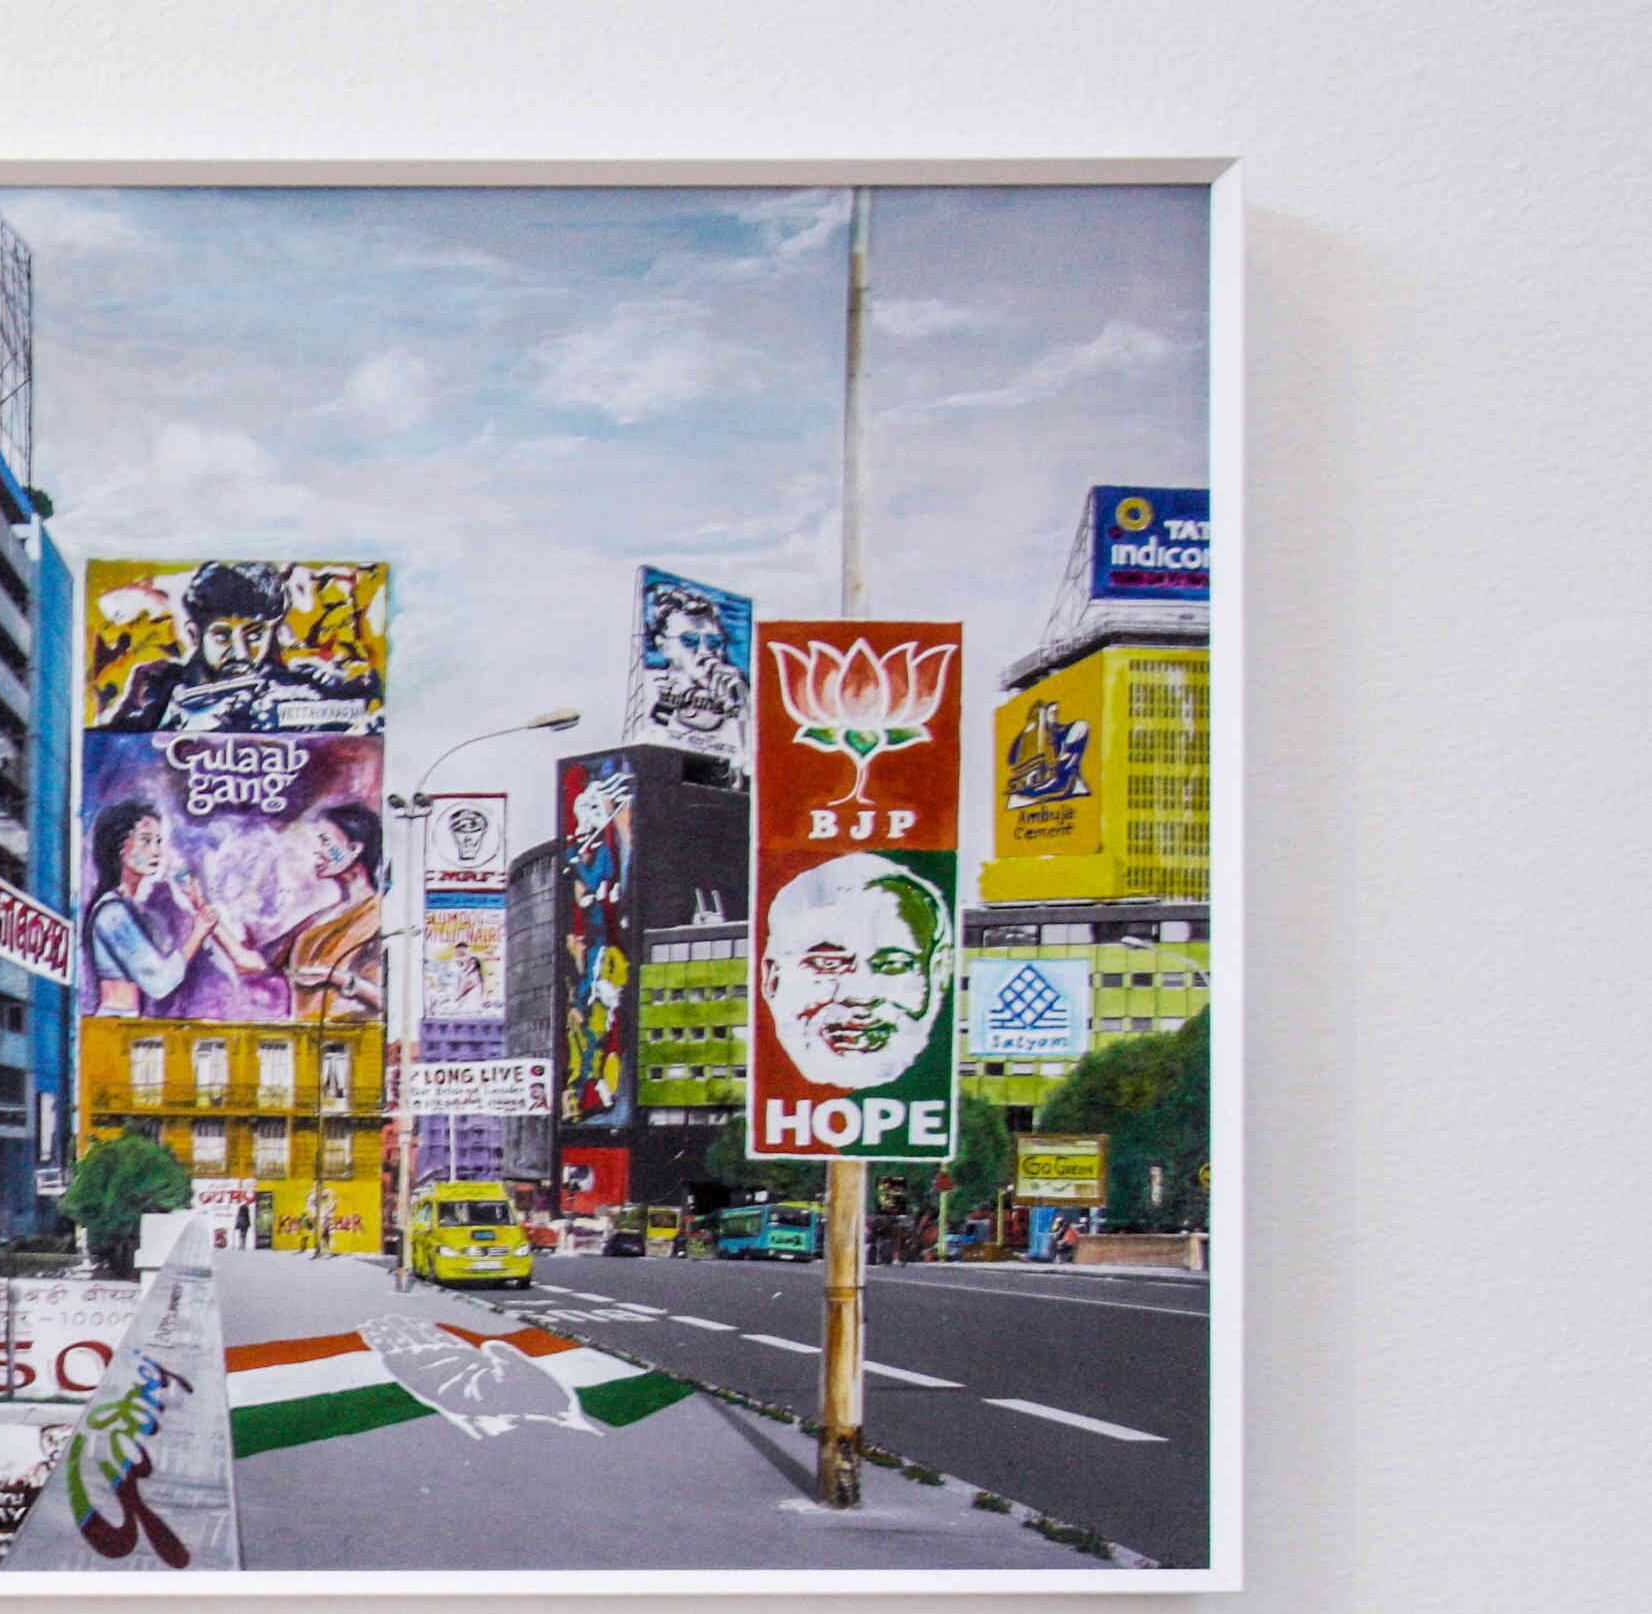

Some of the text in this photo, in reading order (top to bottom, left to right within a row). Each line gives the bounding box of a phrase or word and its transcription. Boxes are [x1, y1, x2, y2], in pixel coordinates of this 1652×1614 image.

[154, 733, 310, 776] Gulaab
[186, 771, 299, 816] gang
[808, 810, 917, 841] BJP
[424, 1065, 524, 1085] LONG LIVE
[765, 1096, 948, 1147] HOPE
